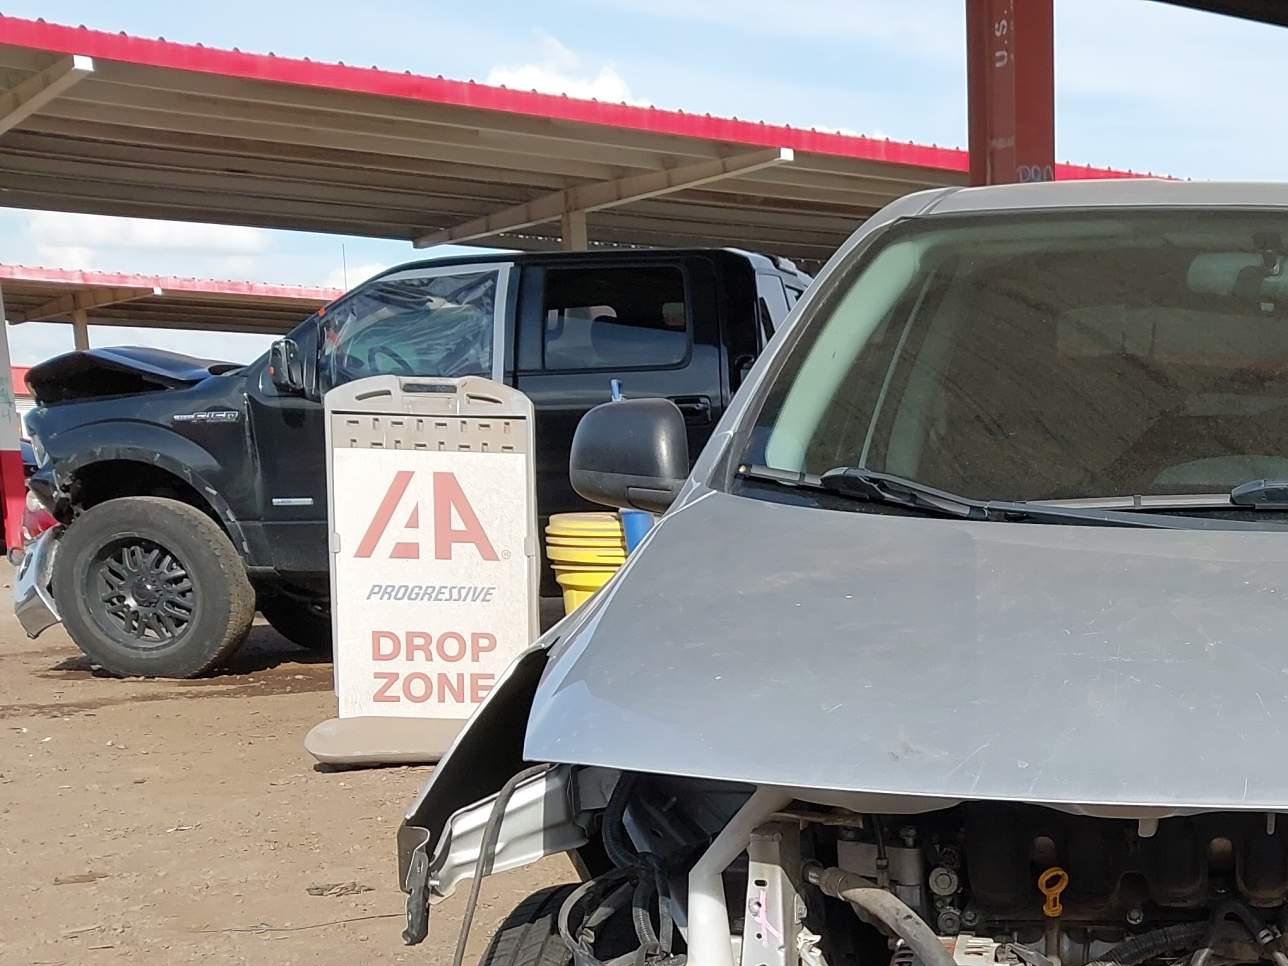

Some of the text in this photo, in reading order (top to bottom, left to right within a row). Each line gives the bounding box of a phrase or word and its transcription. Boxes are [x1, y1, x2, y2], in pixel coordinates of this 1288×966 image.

[994, 9, 1008, 68] U.S.
[366, 584, 497, 603] PROGRESSIVE
[371, 630, 498, 663] DROP
[372, 671, 496, 704] ZONE
